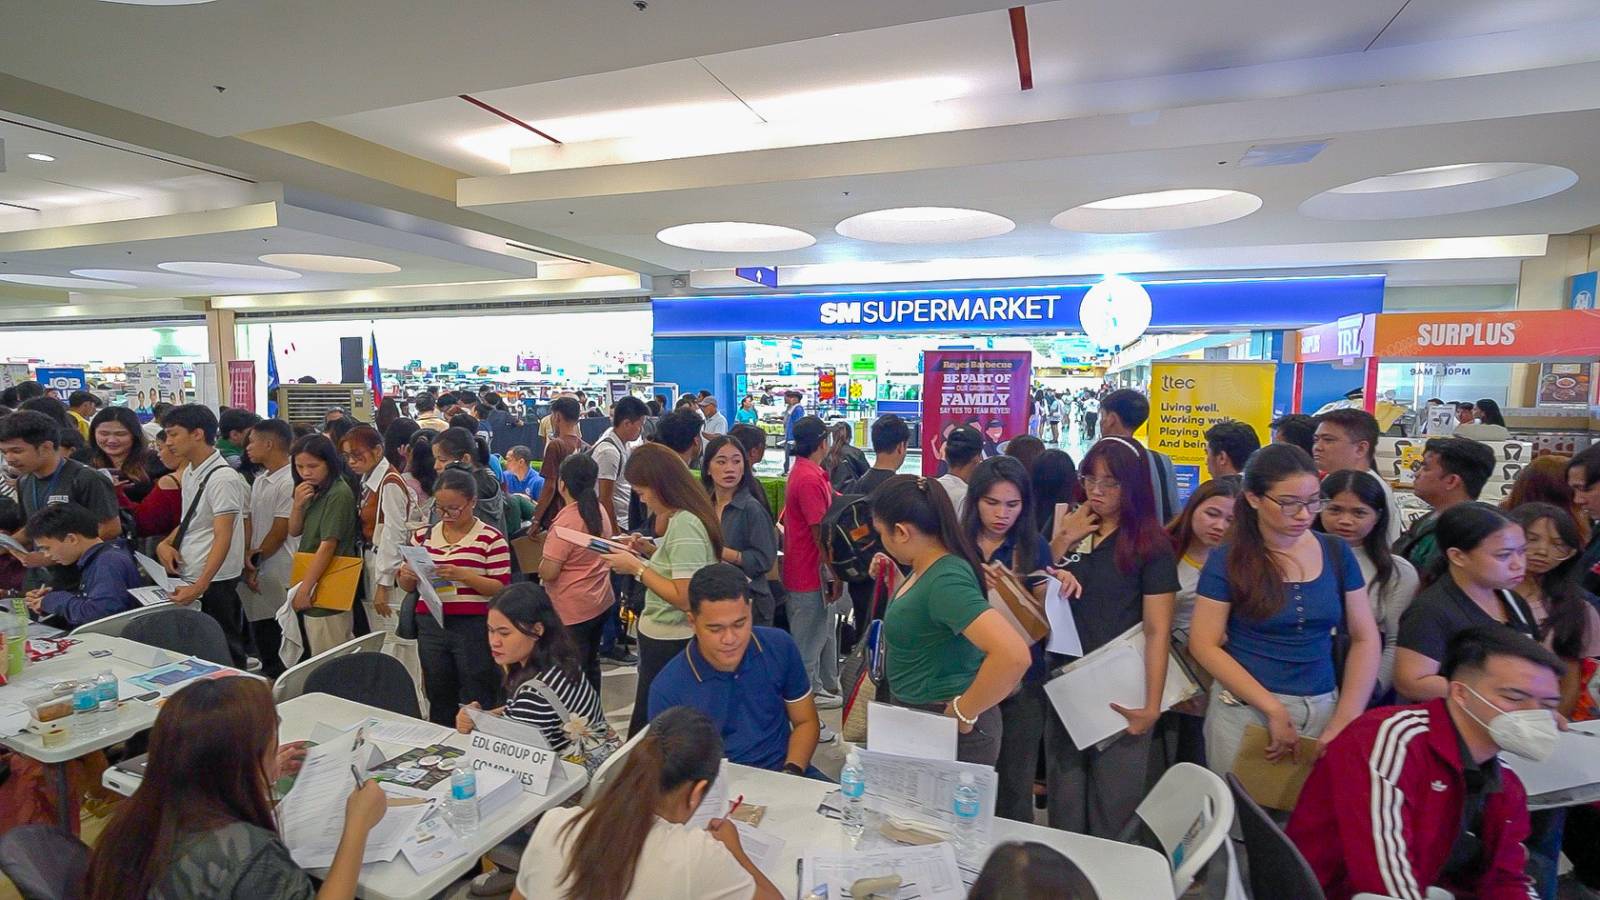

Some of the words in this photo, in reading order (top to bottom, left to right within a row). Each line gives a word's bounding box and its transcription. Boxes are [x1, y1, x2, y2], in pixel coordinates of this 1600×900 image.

[820, 302, 860, 323] SM
[863, 295, 1061, 323] SUPERMARKET
[1418, 323, 1515, 346] SURPLUS
[943, 361, 969, 370] Reyes
[971, 361, 1013, 369] Barbecue
[44, 377, 81, 389] JOB
[943, 374, 960, 383] BE
[961, 374, 994, 383] PART
[995, 374, 1012, 383] OF
[1161, 375, 1196, 391] ttec
[941, 393, 1010, 406] FAMILY
[1161, 403, 1192, 413] Living
[1195, 404, 1219, 412] well.
[1160, 415, 1204, 426] Working
[1160, 427, 1199, 437] Playing
[1159, 440, 1180, 448] And
[1183, 440, 1206, 449] bein
[472, 736, 490, 751] EDL
[492, 741, 530, 760] GROUP
[532, 751, 548, 765] OF
